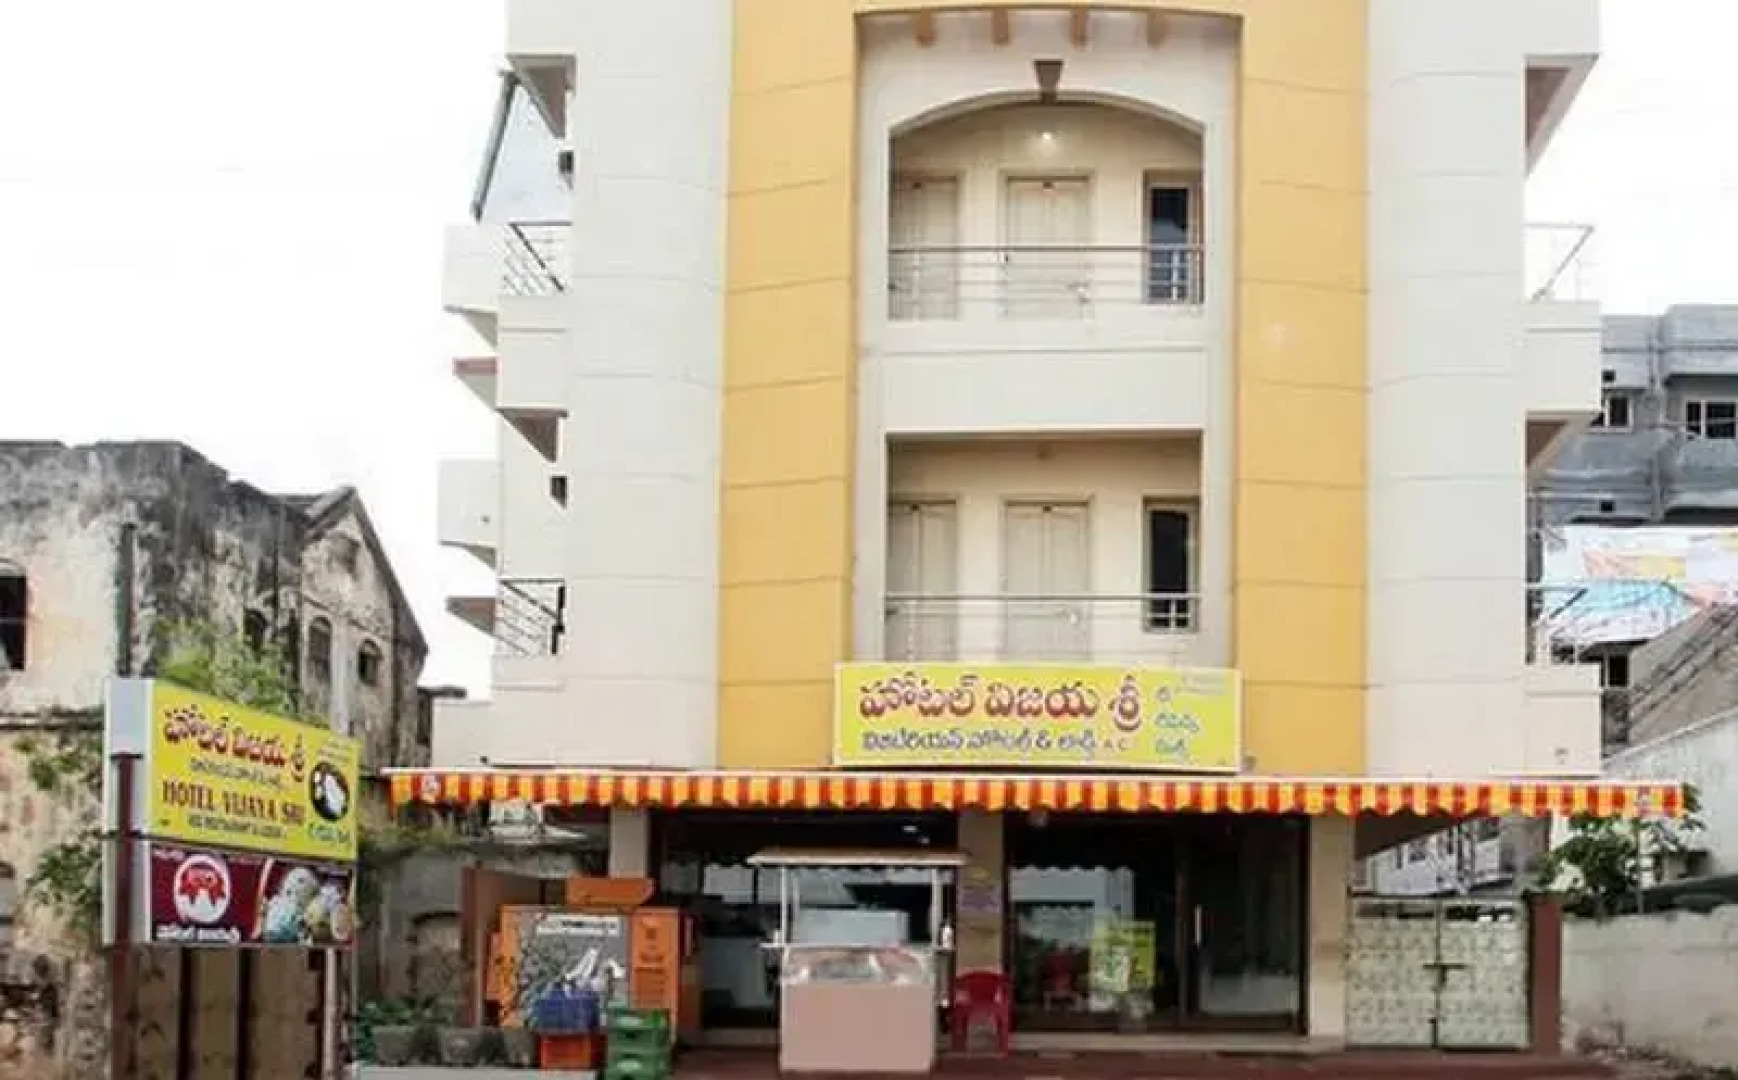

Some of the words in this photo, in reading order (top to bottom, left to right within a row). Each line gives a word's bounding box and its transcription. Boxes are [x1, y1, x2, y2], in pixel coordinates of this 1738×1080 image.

[860, 671, 978, 718] హోటల్
[985, 681, 1099, 718] విజయ
[1108, 674, 1142, 732] శ్రీ
